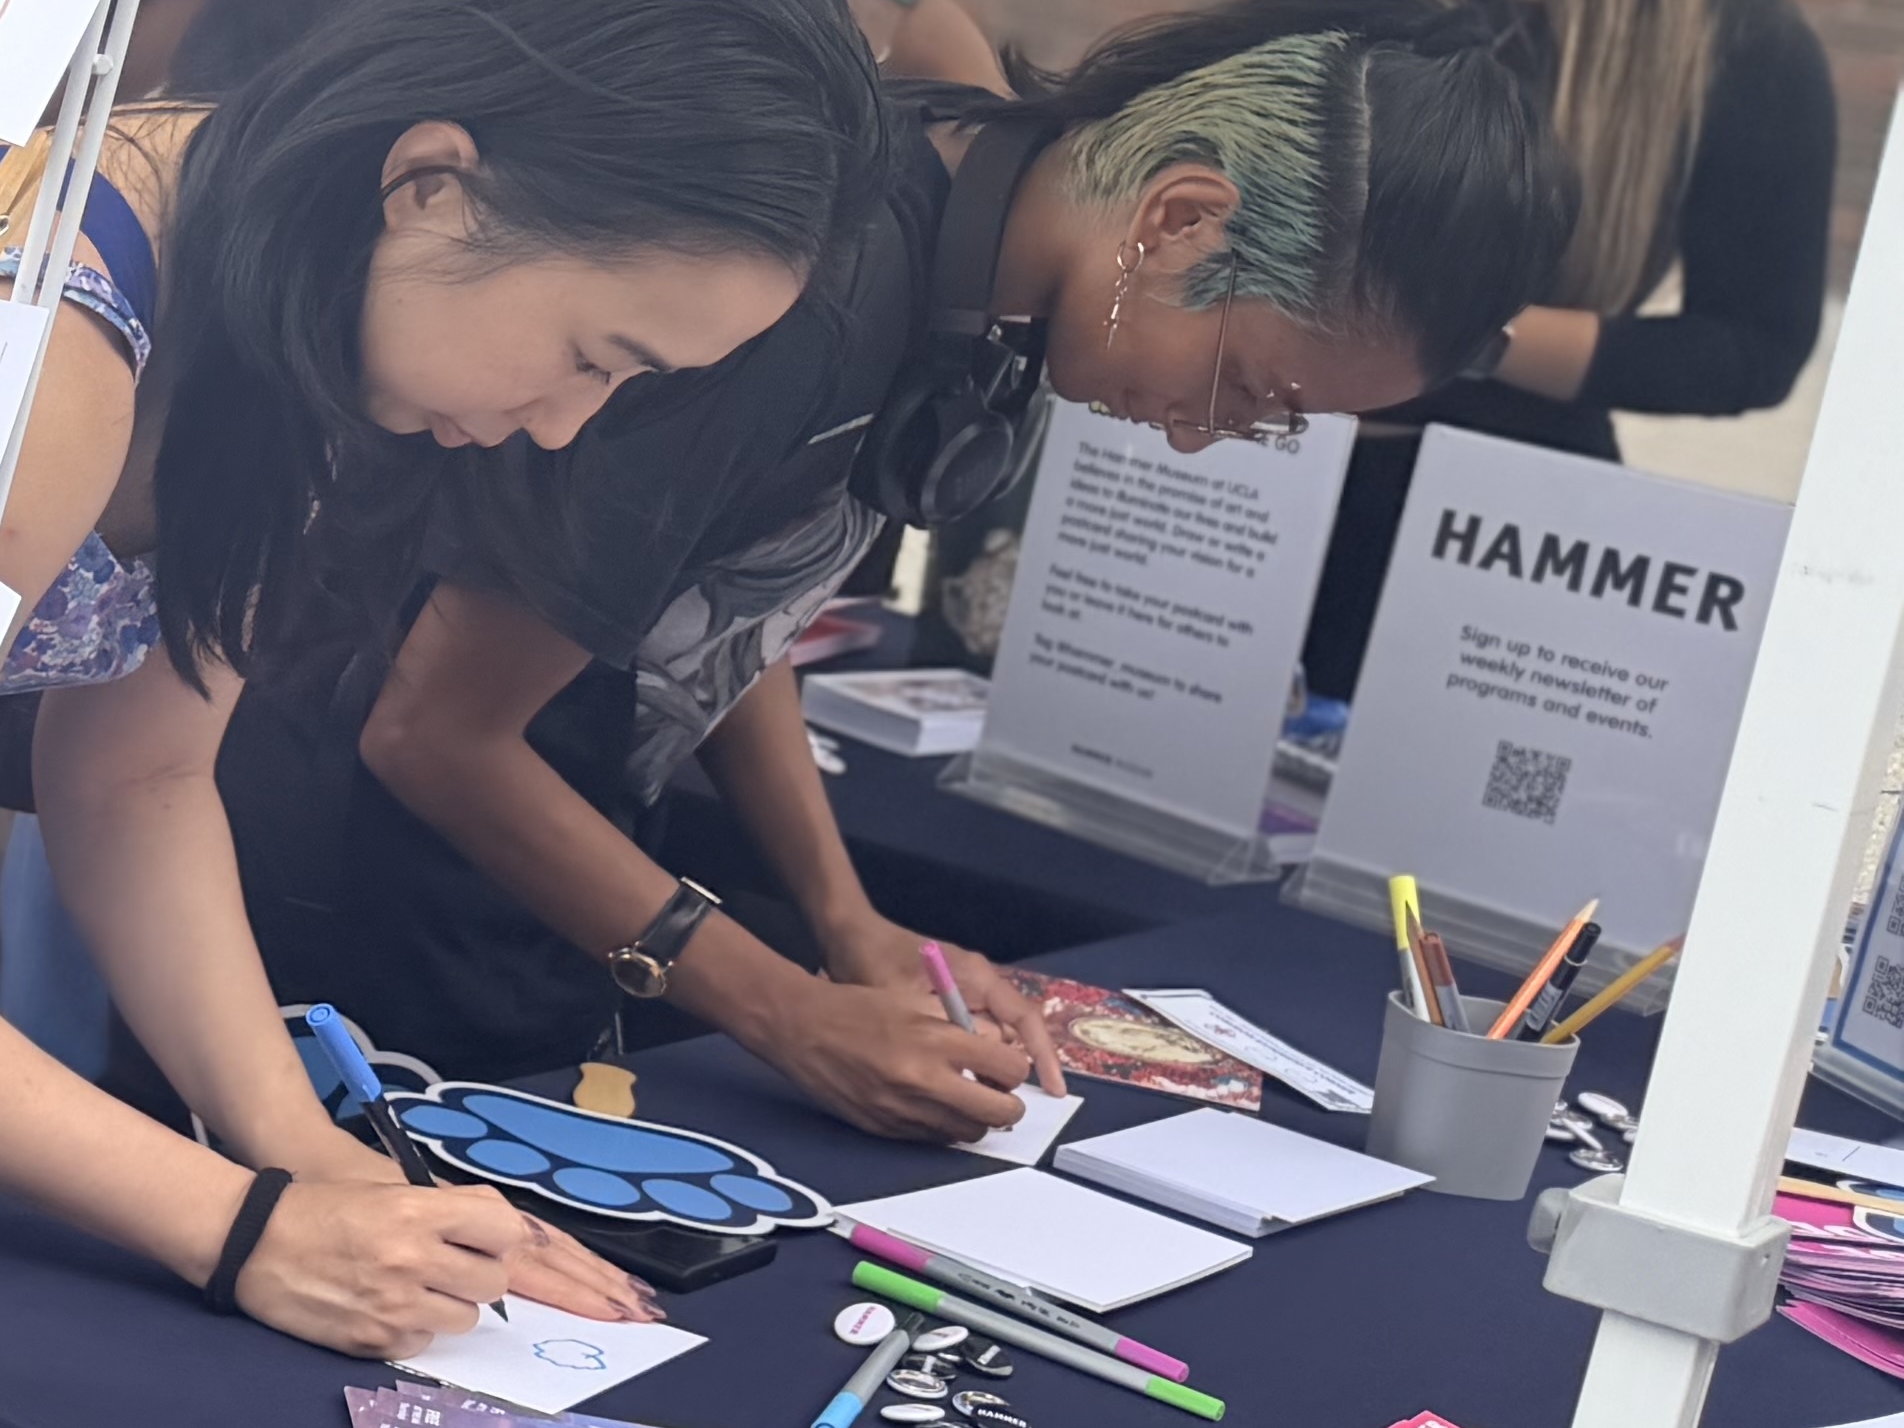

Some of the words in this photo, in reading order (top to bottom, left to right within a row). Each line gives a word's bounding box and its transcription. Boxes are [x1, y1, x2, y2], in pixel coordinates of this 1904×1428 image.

[1079, 441, 1100, 458] The
[1156, 461, 1209, 488] Museum
[1211, 474, 1226, 491] at
[1228, 479, 1260, 501] UCLA
[1136, 474, 1156, 492] the
[1245, 503, 1269, 523] and
[1430, 507, 1746, 633] HAMMER
[1460, 624, 1501, 649] Sign
[1507, 640, 1530, 660] up
[1537, 645, 1555, 663] to
[1561, 653, 1630, 683] receive
[1636, 672, 1669, 693] our
[1460, 648, 1526, 684] weekly
[1530, 668, 1631, 707] newsletter
[1637, 696, 1658, 715] of
[1446, 671, 1537, 709] programs
[1544, 696, 1580, 720] and
[1586, 707, 1653, 740] events.
